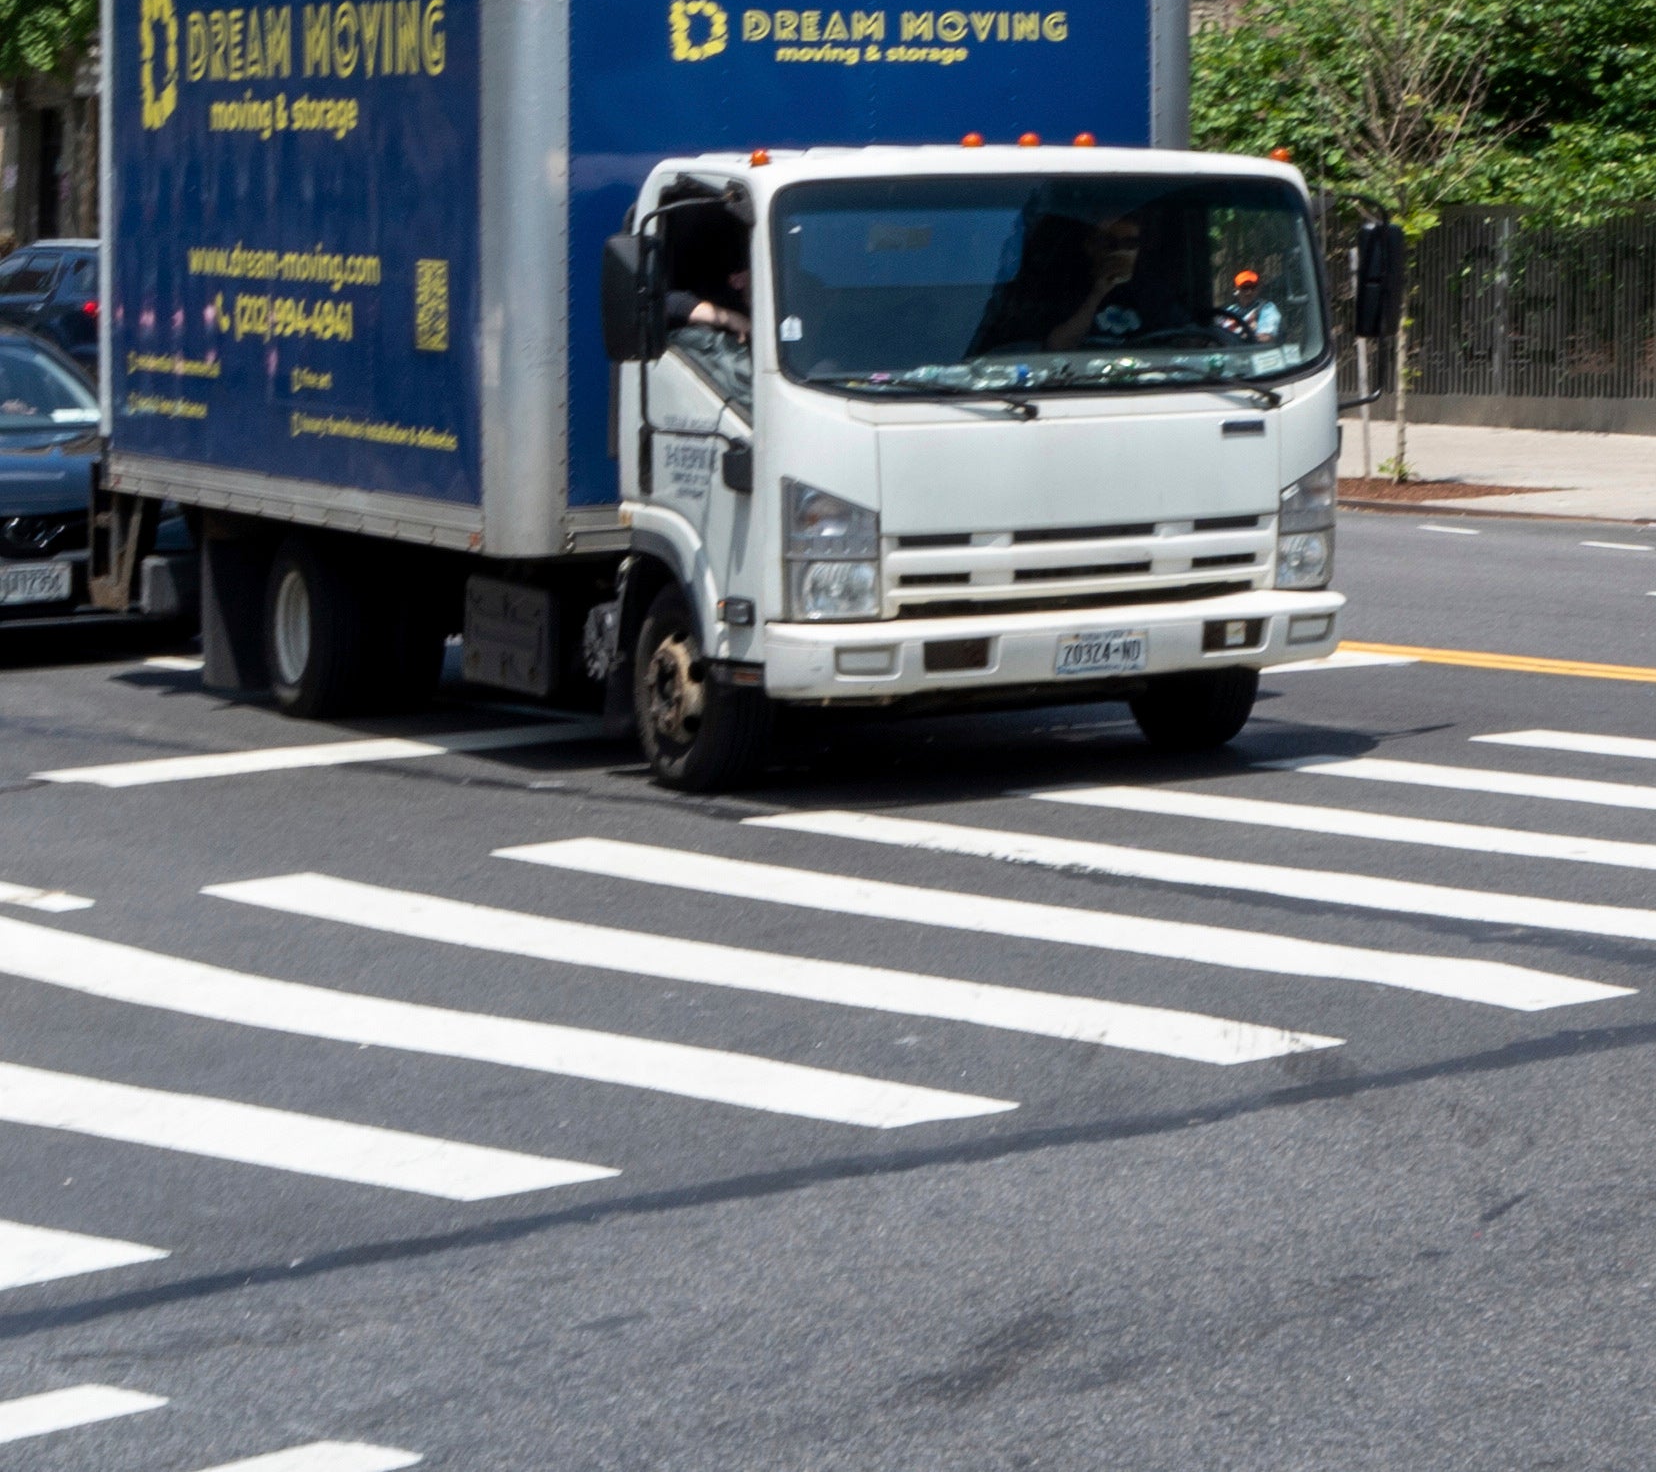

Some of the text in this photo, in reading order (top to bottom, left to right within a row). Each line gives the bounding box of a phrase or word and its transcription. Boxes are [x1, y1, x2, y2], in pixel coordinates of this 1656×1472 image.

[186, 6, 292, 81] DREAM
[742, 10, 1068, 42] DREAM MOVING
[775, 43, 969, 66] moving & storage
[209, 88, 274, 140] moving
[290, 93, 359, 140] storage
[187, 240, 382, 293] www.dream-moving.com
